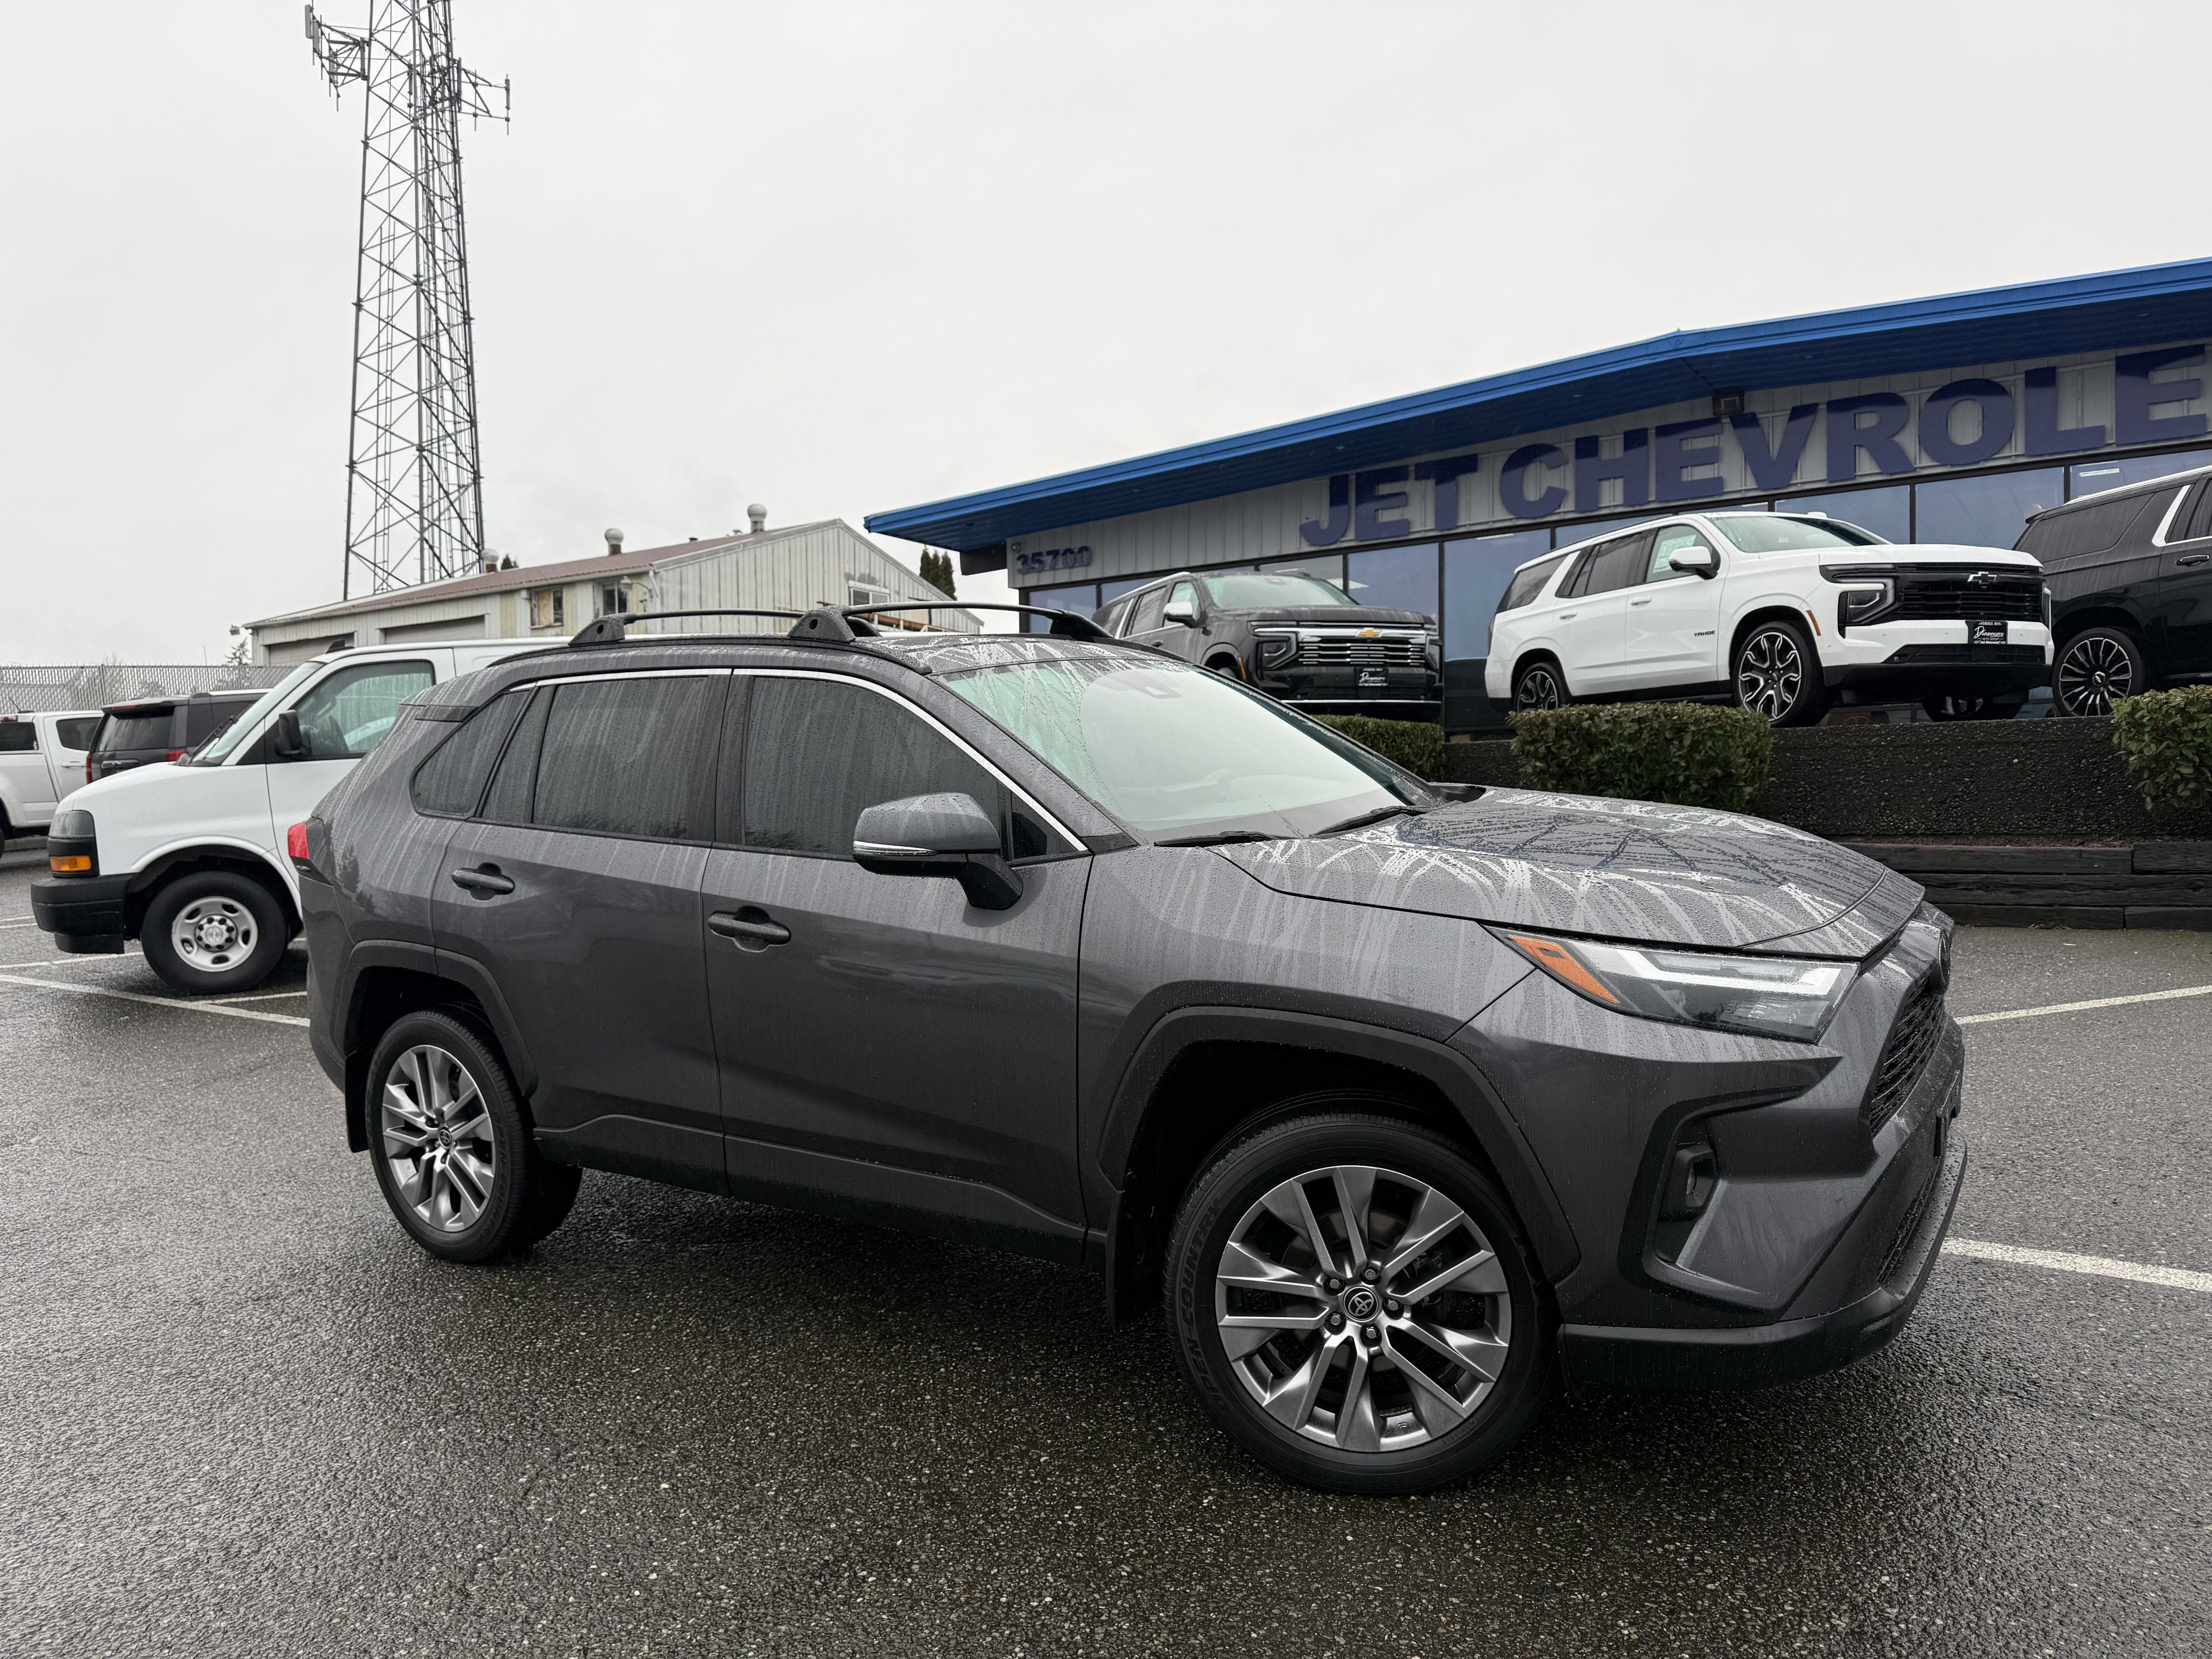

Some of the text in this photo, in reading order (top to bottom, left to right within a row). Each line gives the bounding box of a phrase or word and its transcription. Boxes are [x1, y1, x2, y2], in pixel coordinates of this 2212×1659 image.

[1300, 344, 2207, 546] JET CHEVROLE
[1017, 546, 1092, 575] 35700
[1181, 1197, 1227, 1411] OPEN COUNTRY
